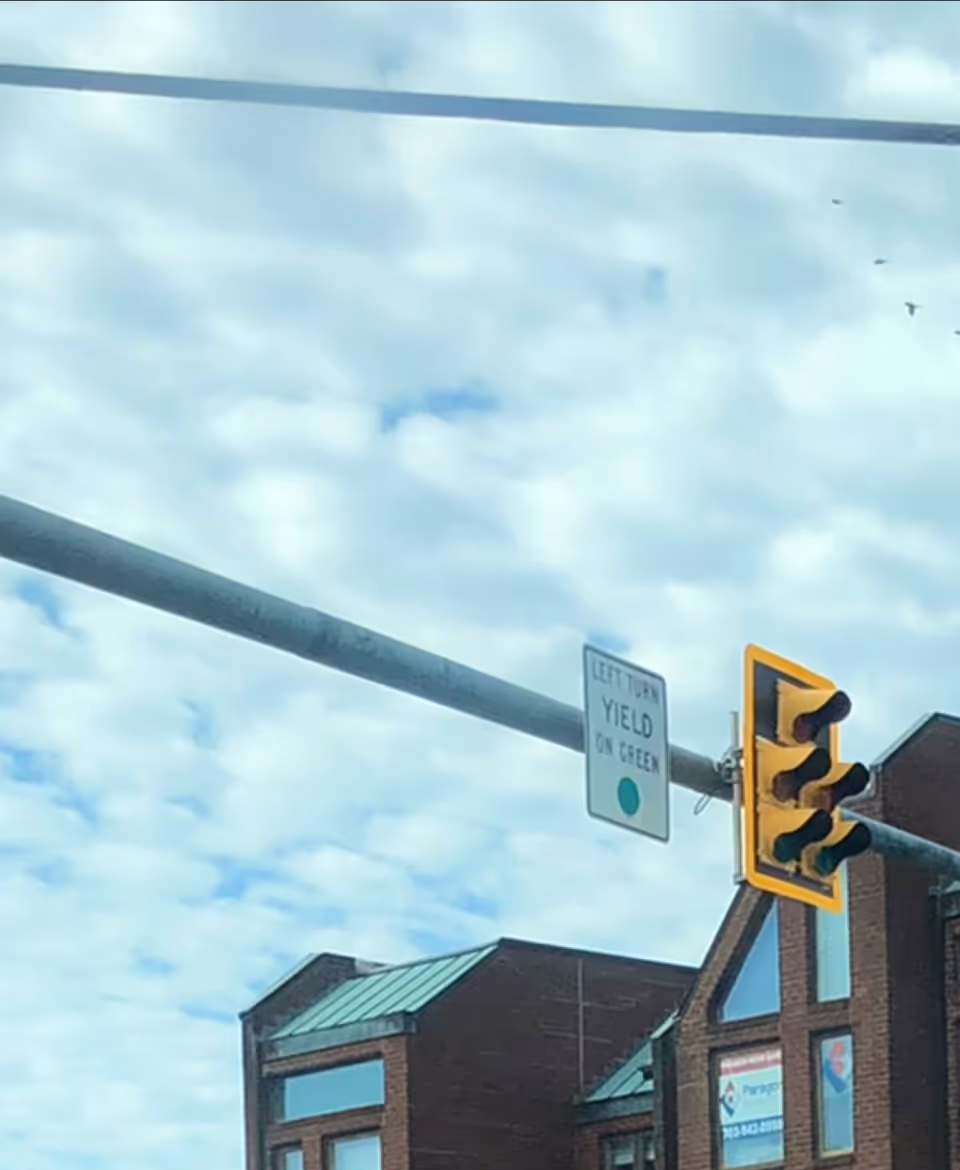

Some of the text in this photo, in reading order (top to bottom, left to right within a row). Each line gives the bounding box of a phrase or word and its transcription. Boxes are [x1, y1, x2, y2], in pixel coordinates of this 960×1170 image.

[591, 661, 660, 704] LEFT TURN
[602, 695, 654, 740] YIELD
[595, 733, 660, 774] ON GREEN
